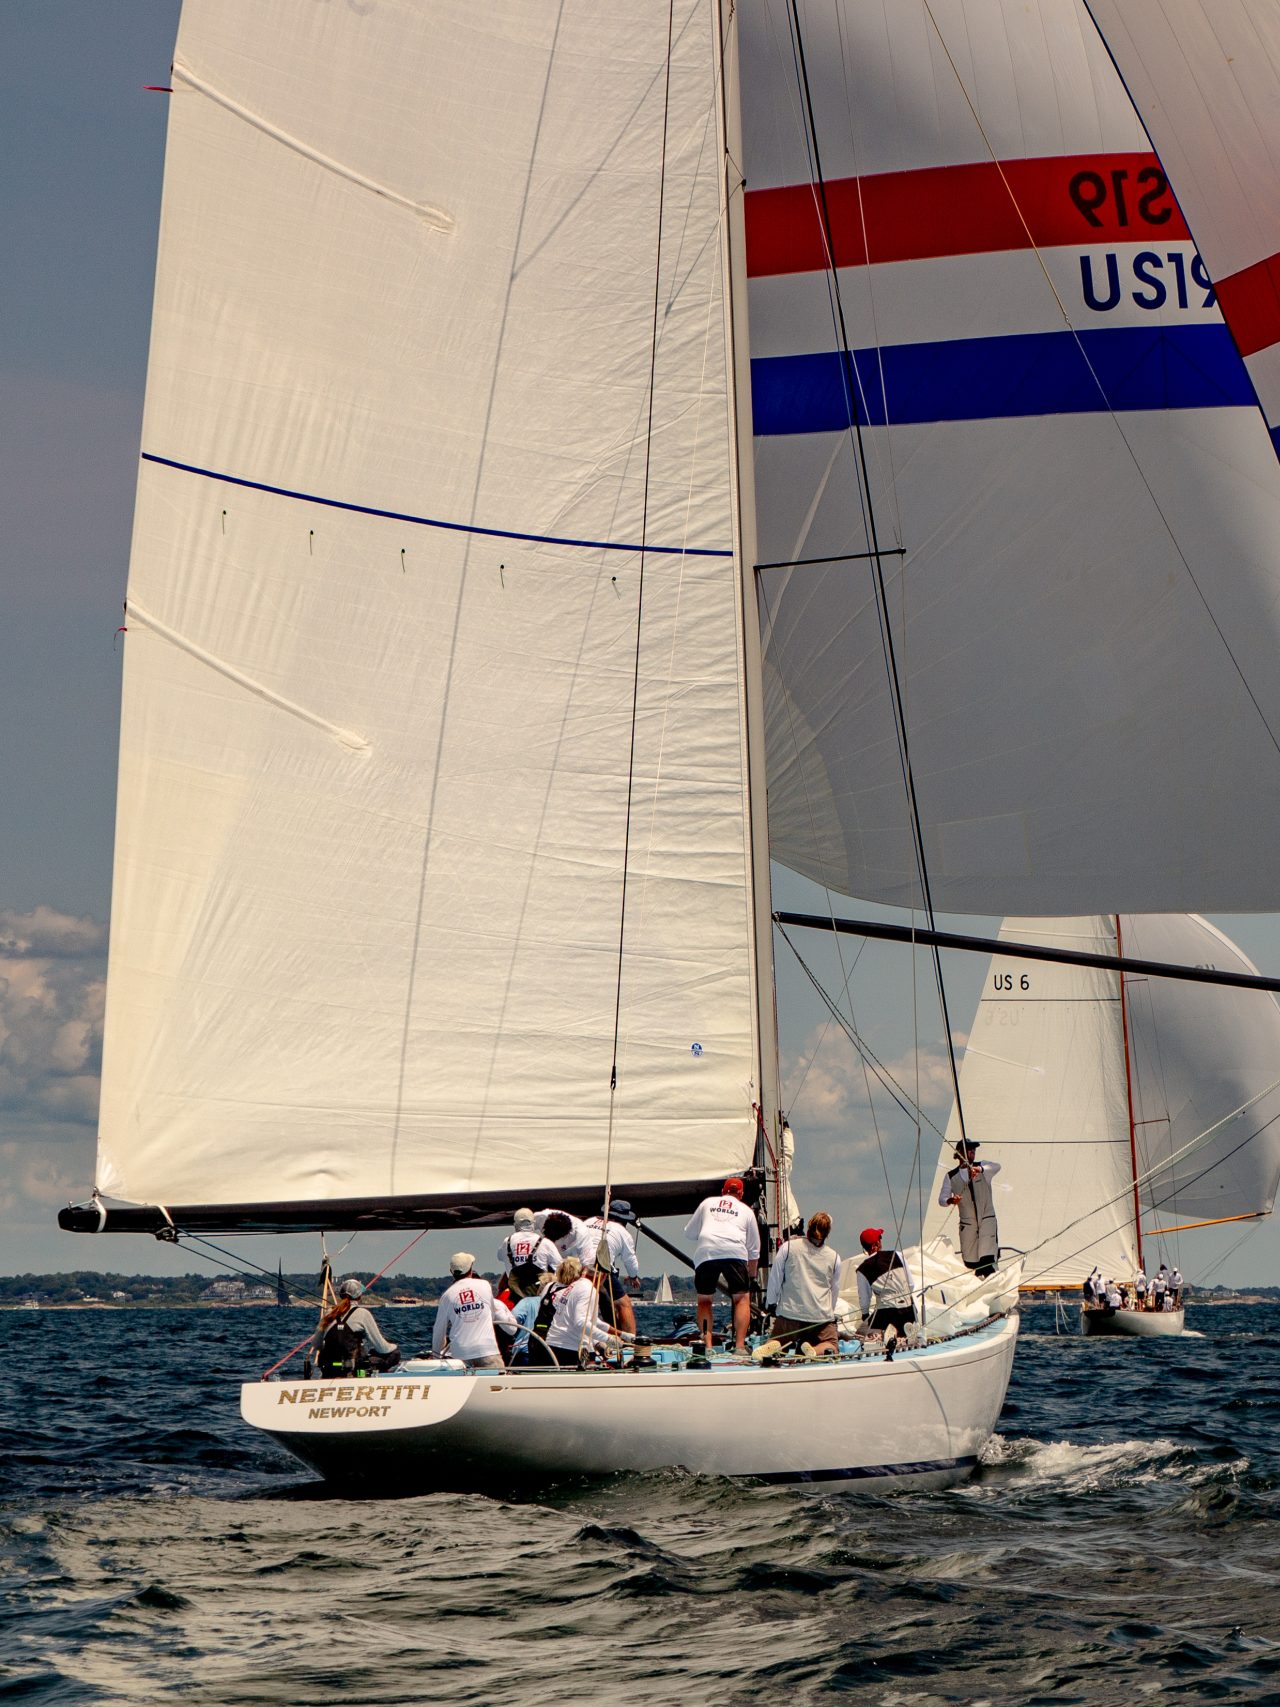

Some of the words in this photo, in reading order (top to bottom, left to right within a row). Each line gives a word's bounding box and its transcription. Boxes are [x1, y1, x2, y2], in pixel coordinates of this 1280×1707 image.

[993, 974, 1013, 990] US
[1020, 974, 1030, 990] 6
[709, 1207, 739, 1217] WORLDS
[459, 1290, 474, 1304] 12
[453, 1303, 485, 1315] WORLDS
[277, 1384, 432, 1405] NEFERTITI
[308, 1405, 392, 1420] NEWPORT
